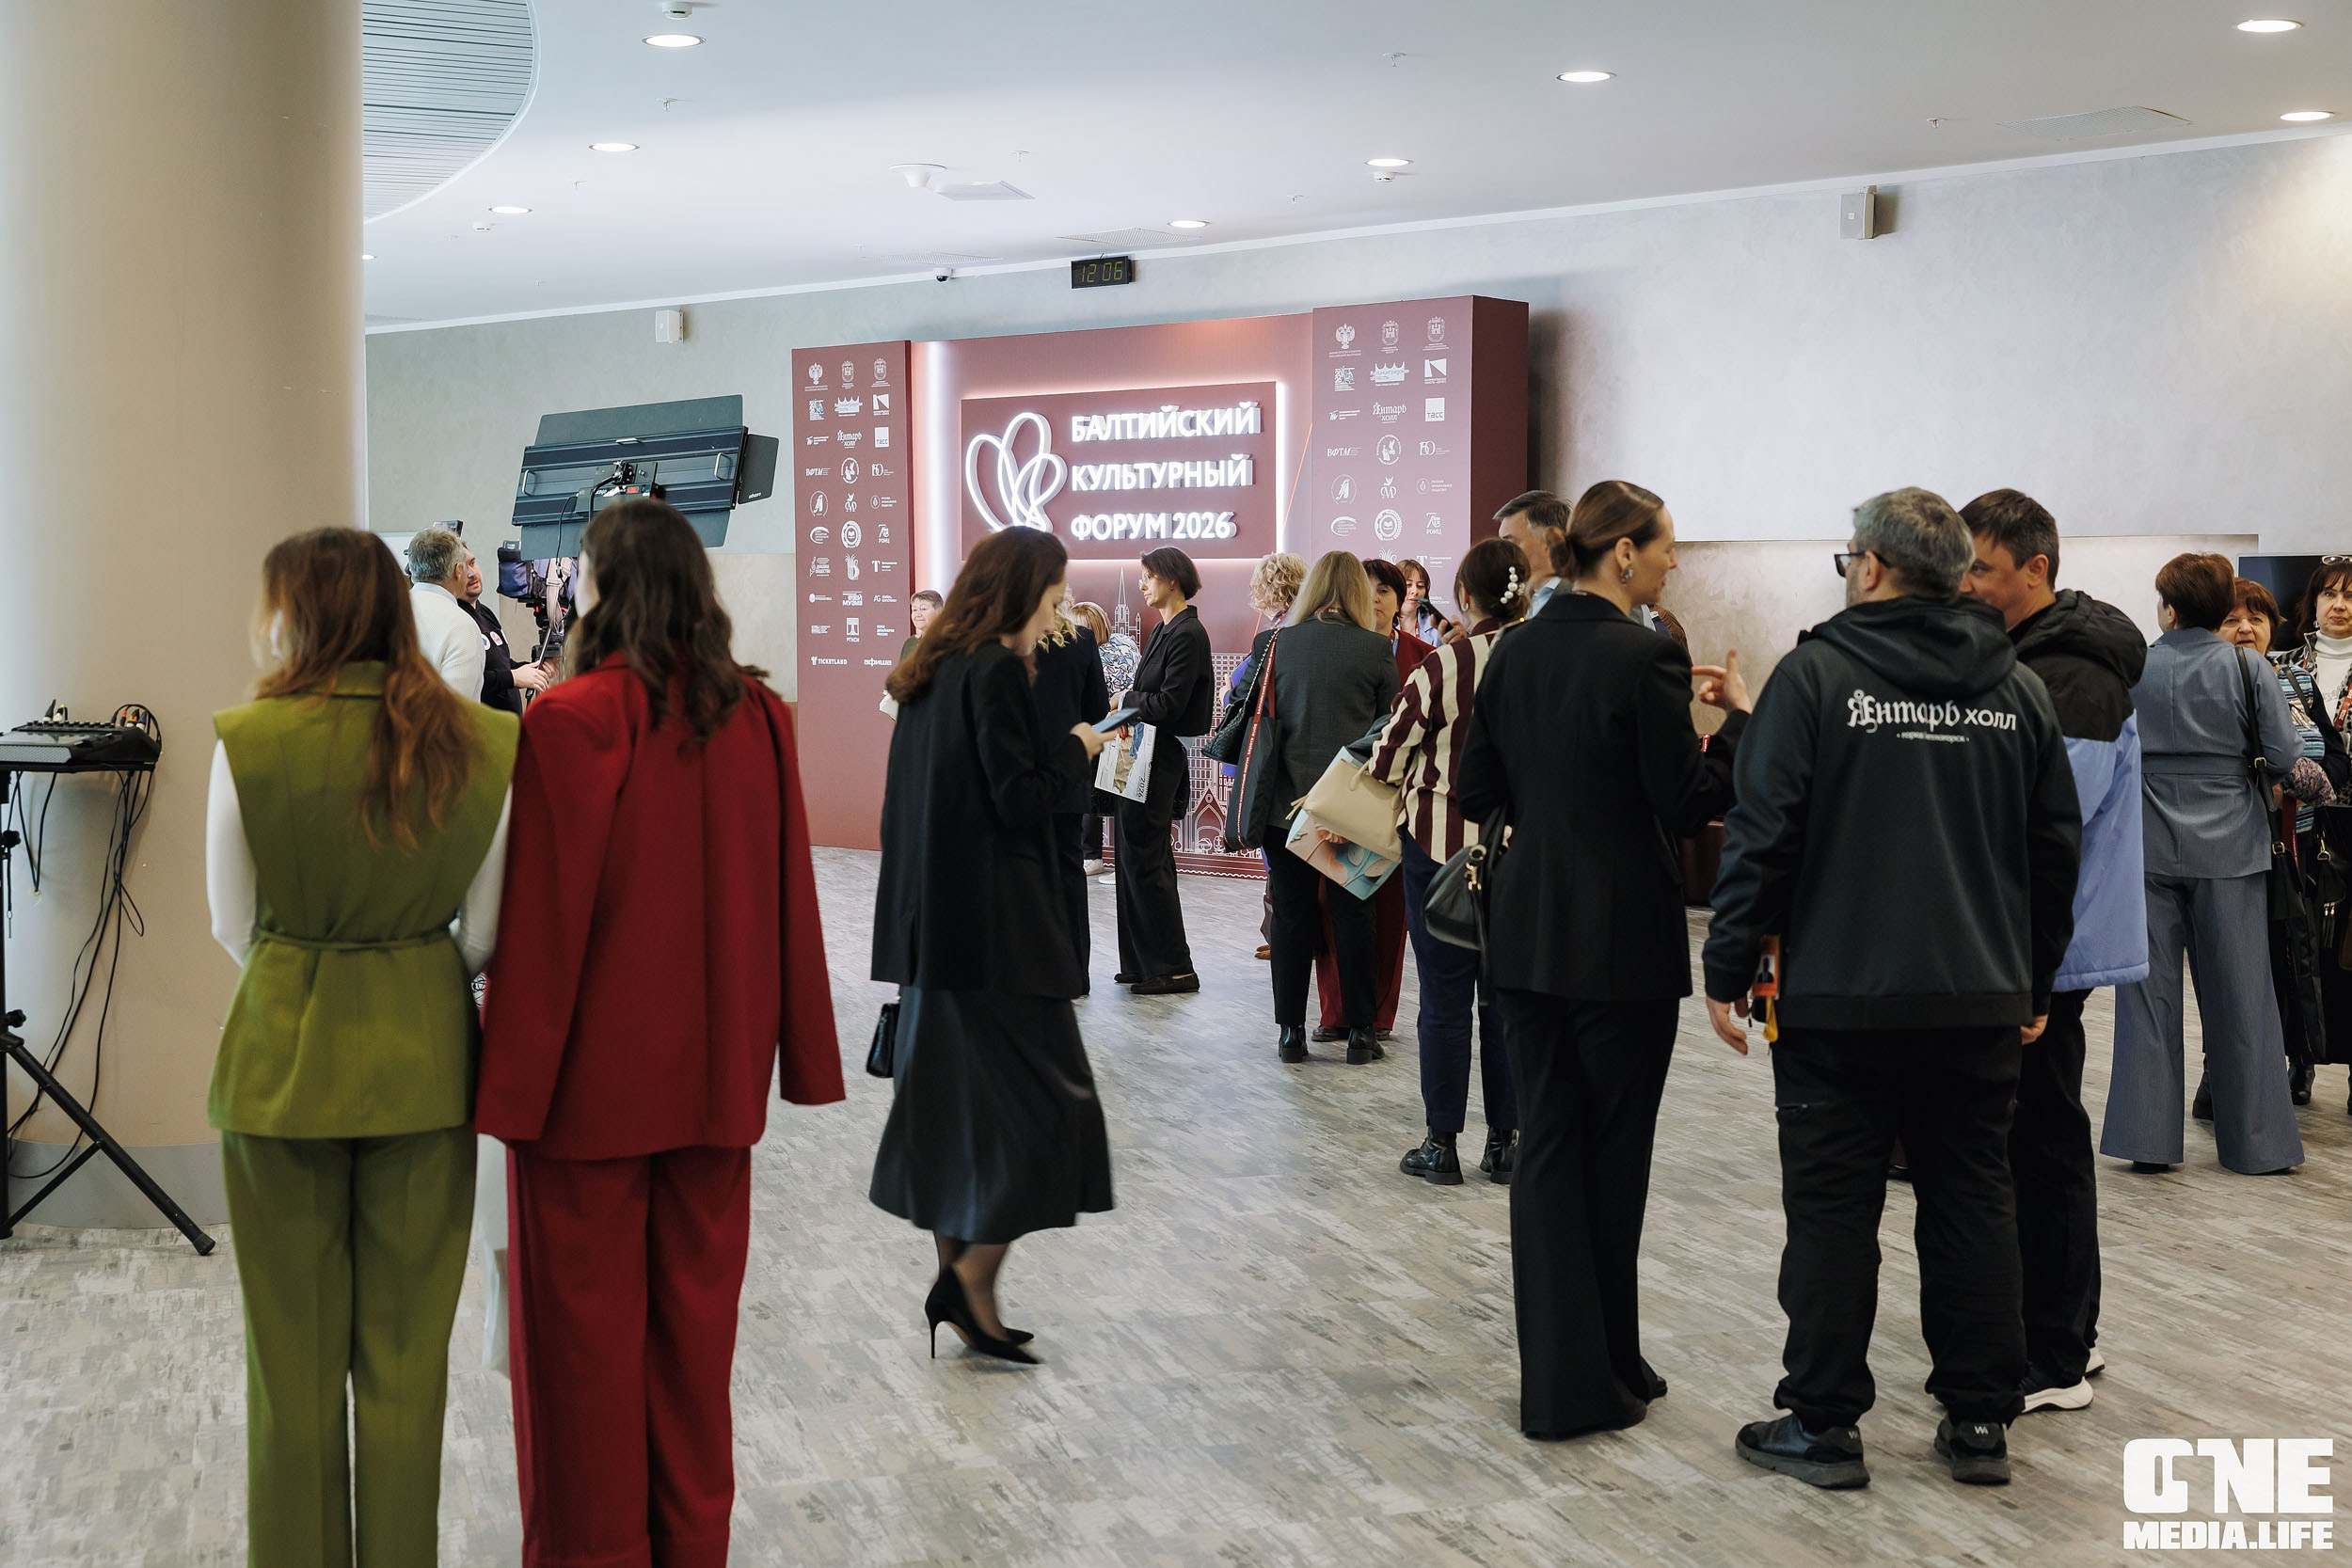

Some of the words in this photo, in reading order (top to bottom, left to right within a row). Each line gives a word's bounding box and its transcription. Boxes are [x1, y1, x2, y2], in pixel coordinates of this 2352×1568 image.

[1071, 401, 1262, 443] БАЛТИЙСКИЙ
[1071, 453, 1253, 491] КУЛЬТУРНЫЙ
[1071, 513, 1172, 540] ФОРУМ
[1172, 512, 1237, 539] 2026
[1847, 689, 1961, 734] Янтарь
